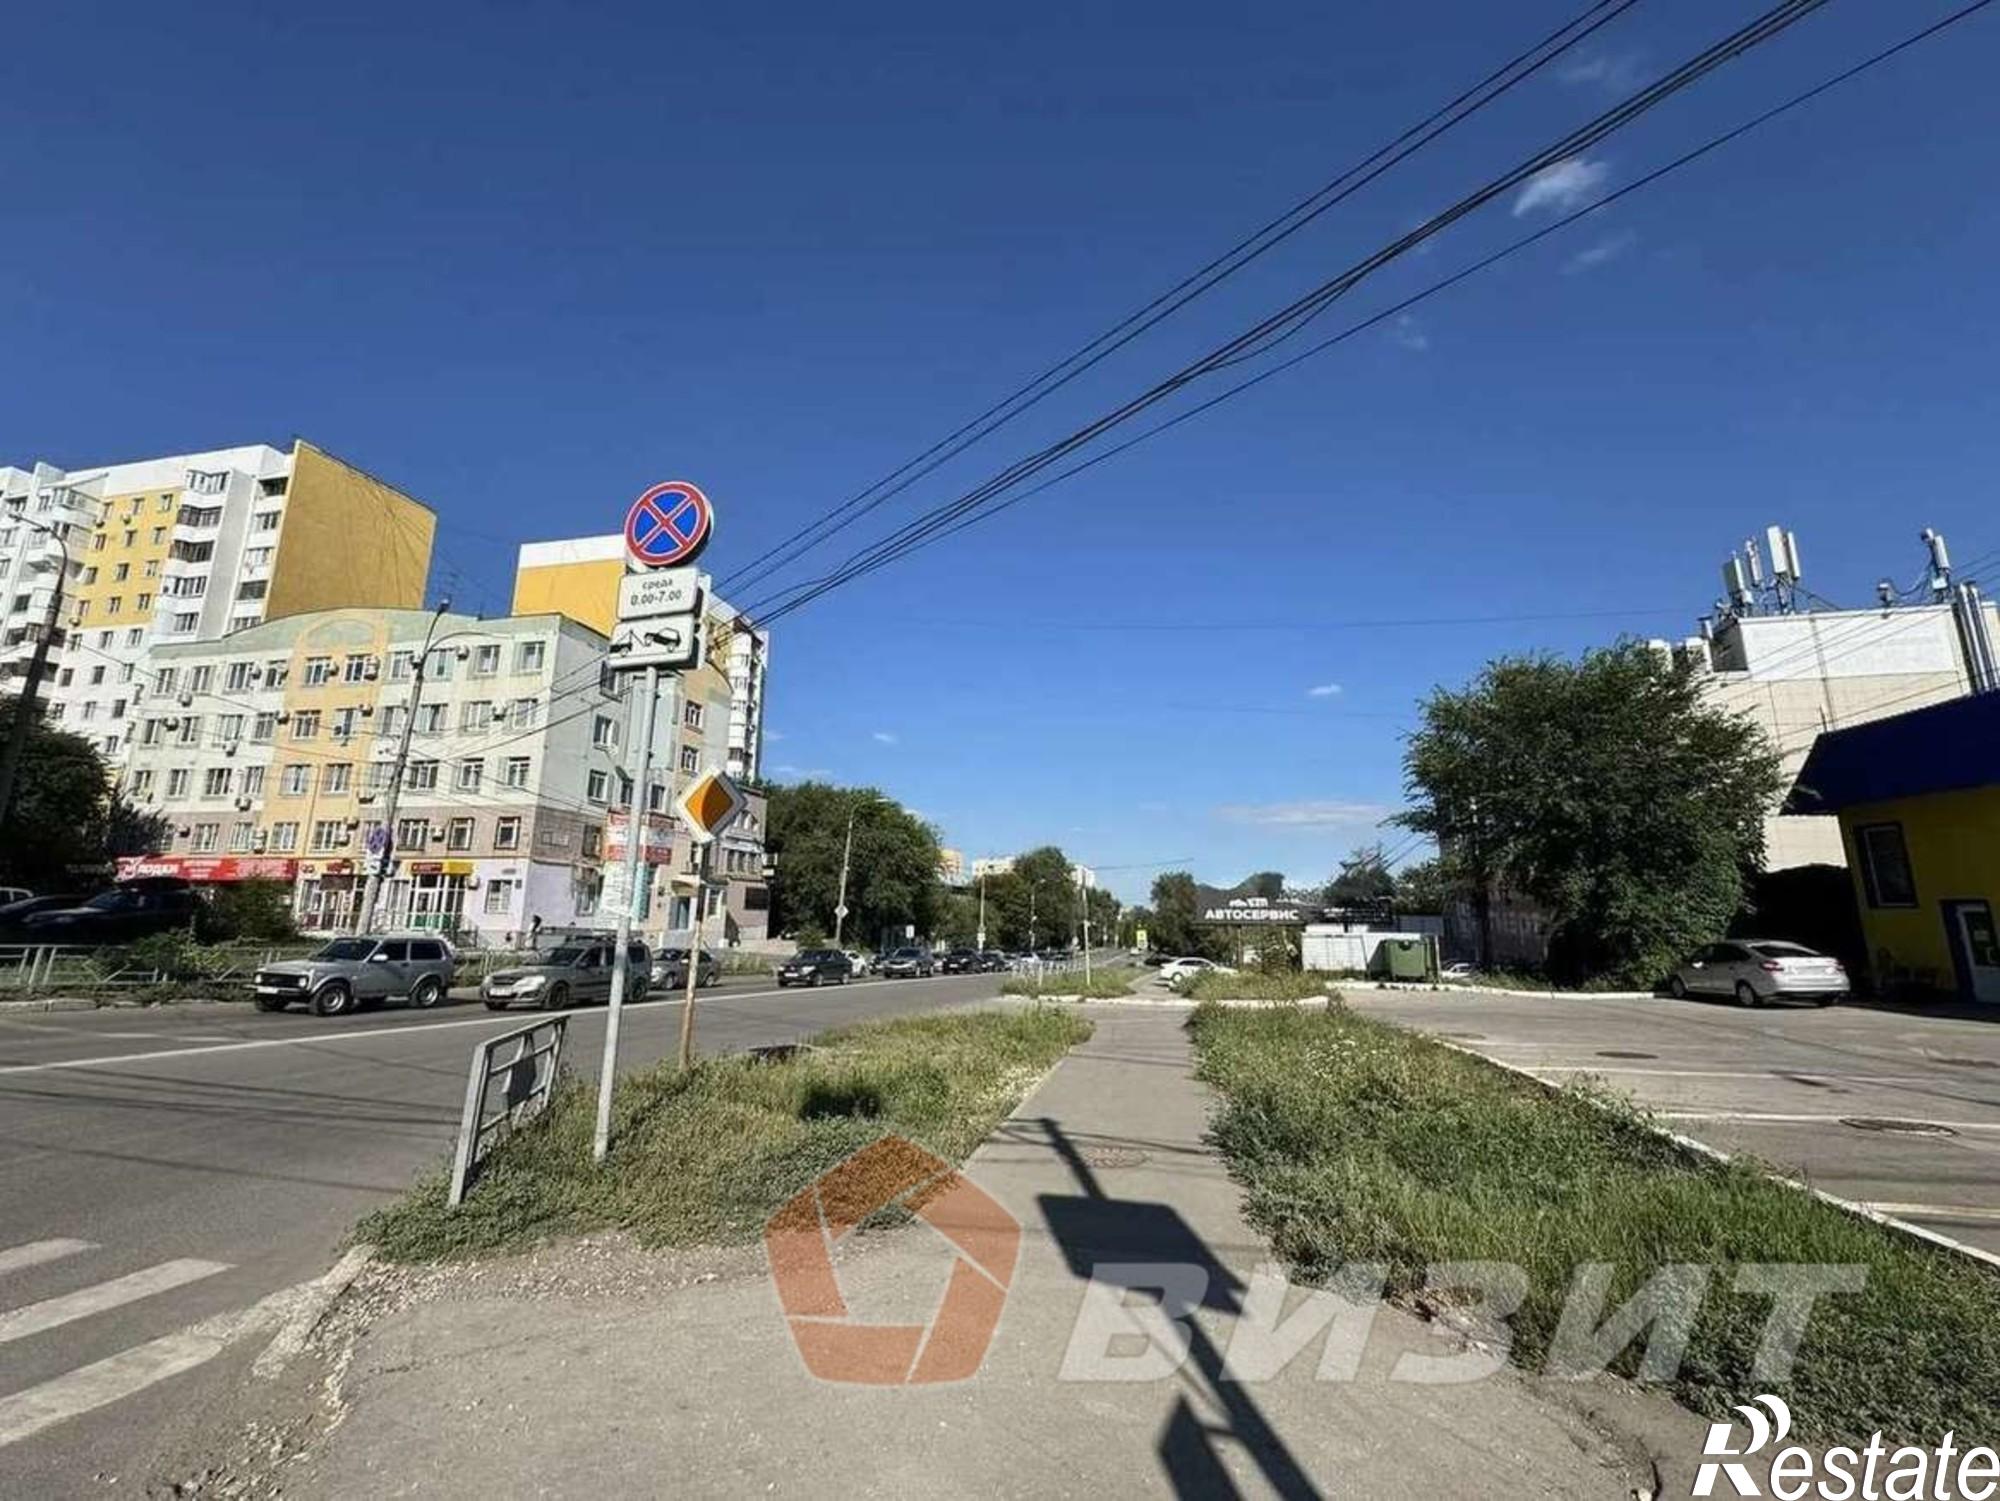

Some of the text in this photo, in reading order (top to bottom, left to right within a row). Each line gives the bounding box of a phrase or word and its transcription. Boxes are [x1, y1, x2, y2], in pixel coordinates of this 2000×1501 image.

[642, 578, 673, 590] среда
[630, 589, 682, 606] 0.00-7.00
[1204, 909, 1299, 920] АВТОСЕРВИС
